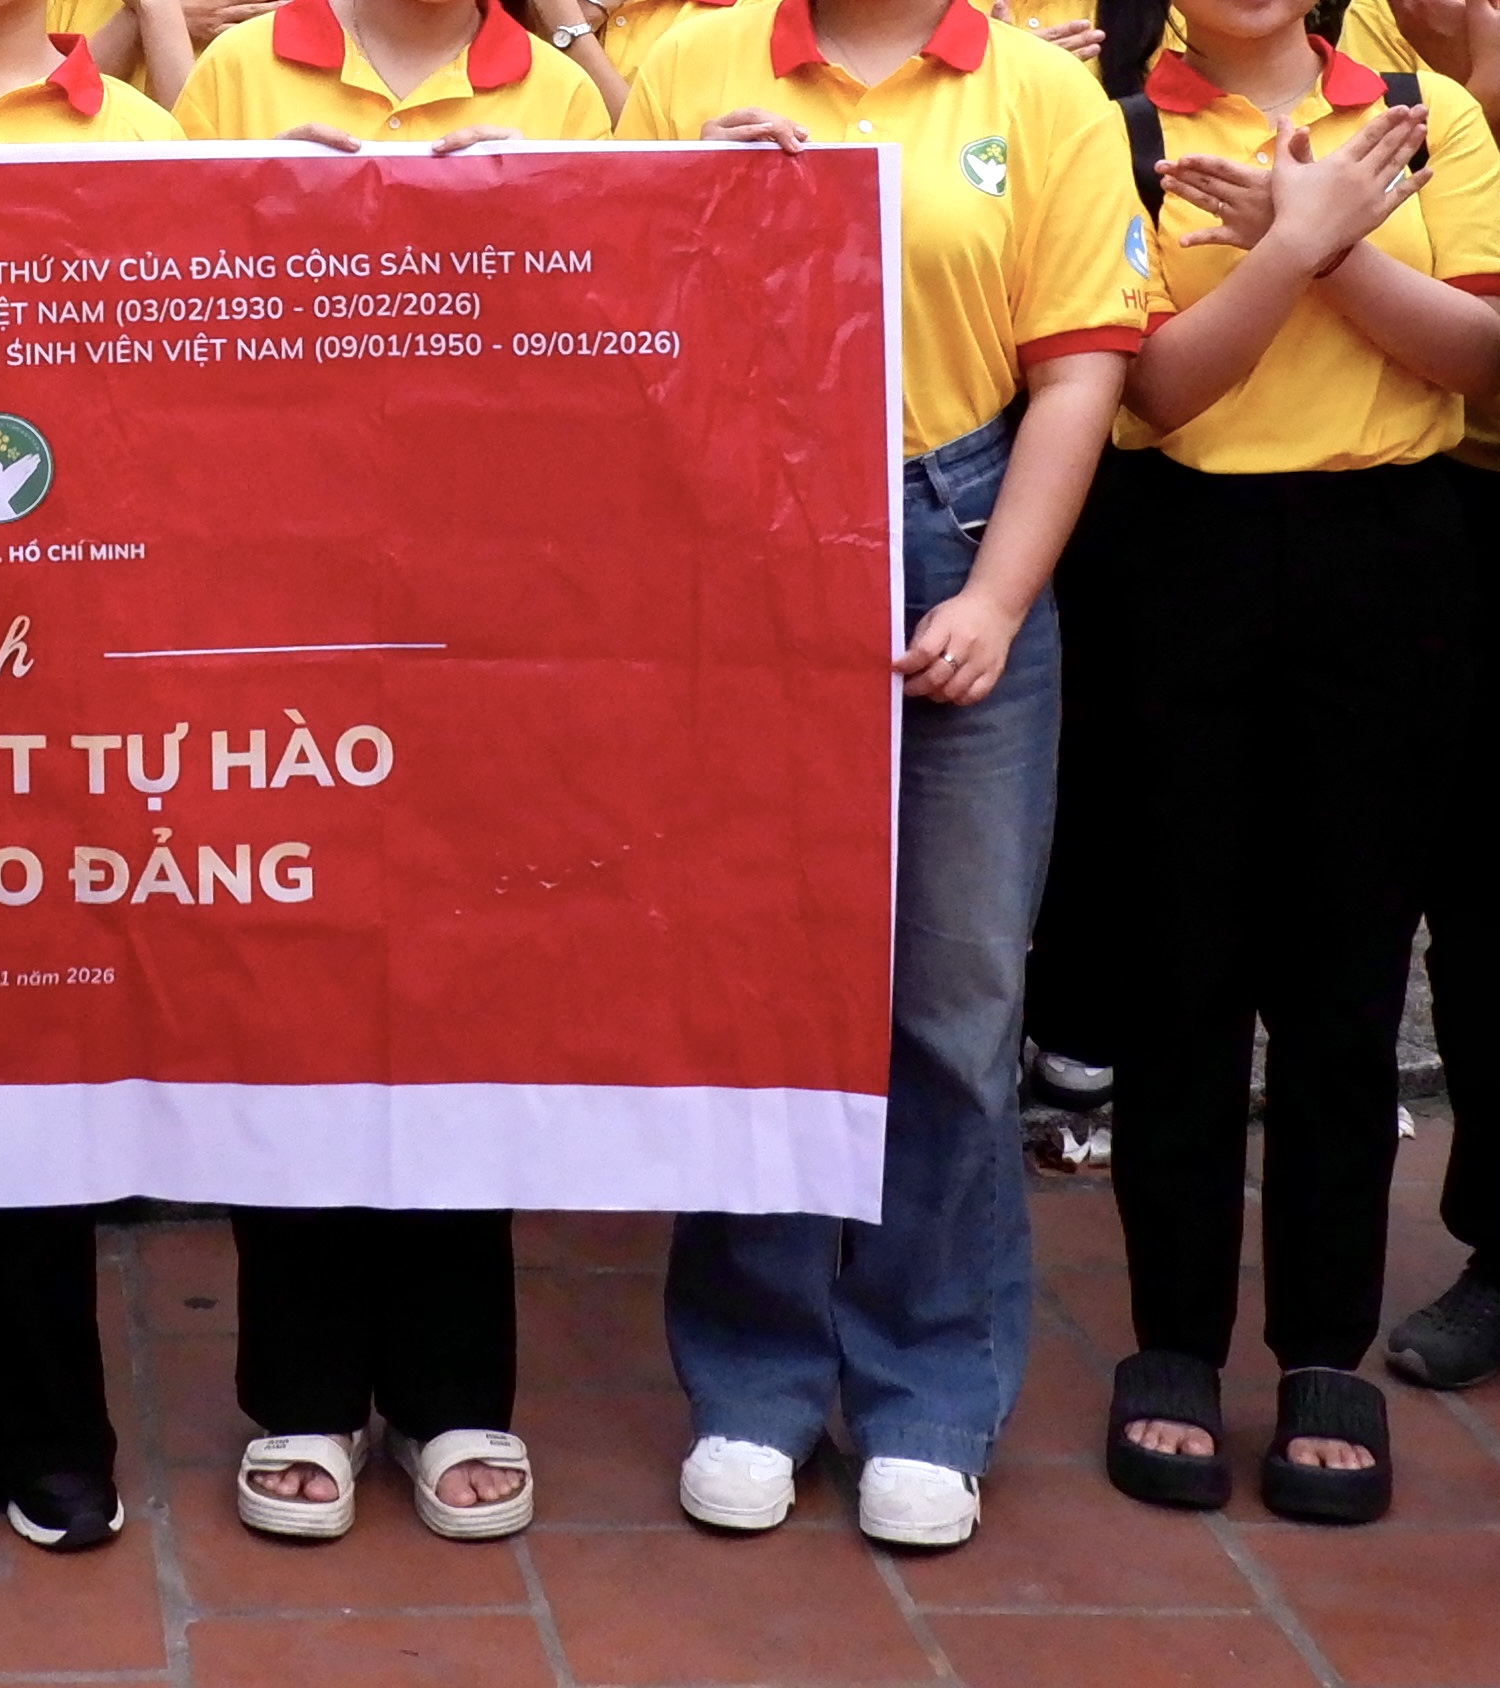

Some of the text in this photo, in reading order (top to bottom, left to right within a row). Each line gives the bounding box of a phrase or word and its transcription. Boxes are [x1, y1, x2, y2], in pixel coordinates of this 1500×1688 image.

[61, 258, 111, 282] XIV
[119, 251, 182, 281] CỦA
[189, 249, 276, 280] ĐẢNG
[286, 247, 370, 283] CỘNG
[380, 245, 441, 276] SẢN
[449, 244, 516, 280] VIỆT
[524, 250, 592, 274] NAM
[38, 300, 104, 324] NAM
[116, 296, 283, 328] (03/02/1930
[313, 292, 480, 320] 03/02/2026)
[6, 337, 76, 366] SINH
[84, 334, 153, 364] VIÊN
[162, 332, 228, 368] VIỆT
[237, 336, 303, 361] NAM
[315, 332, 482, 364] (09/01/1950
[512, 330, 680, 359] 09/01/2026)
[47, 539, 85, 562] CHÍ
[90, 543, 145, 561] MINH
[70, 721, 189, 812] TỰ
[211, 708, 394, 791] HÀO
[68, 827, 314, 905] ĐẢNG
[16, 970, 60, 986] năm
[66, 967, 115, 985] 2026
